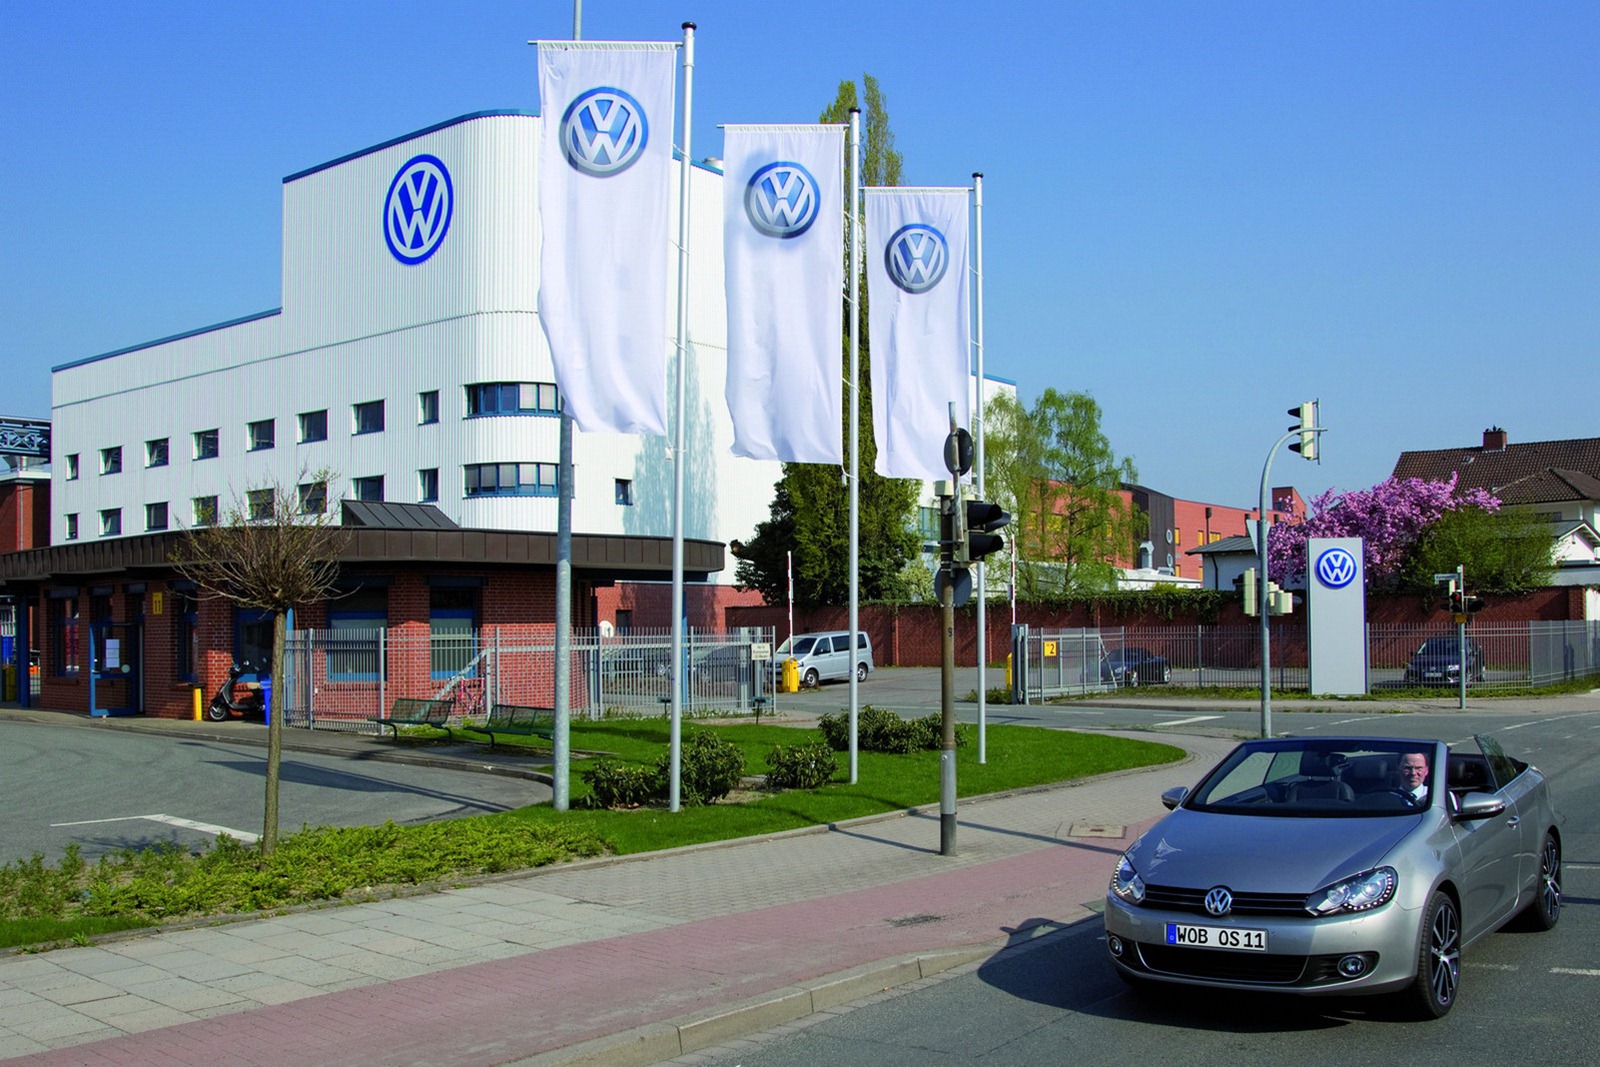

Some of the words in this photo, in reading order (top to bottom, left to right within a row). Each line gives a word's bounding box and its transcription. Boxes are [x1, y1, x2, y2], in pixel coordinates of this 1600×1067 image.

[566, 92, 643, 171] VW
[387, 161, 449, 258] VW
[749, 166, 816, 233] VW
[890, 228, 945, 288] VW
[1320, 551, 1355, 585] VW
[1049, 643, 1055, 655] 2
[1205, 887, 1232, 915] VW
[1177, 927, 1208, 944] WOB
